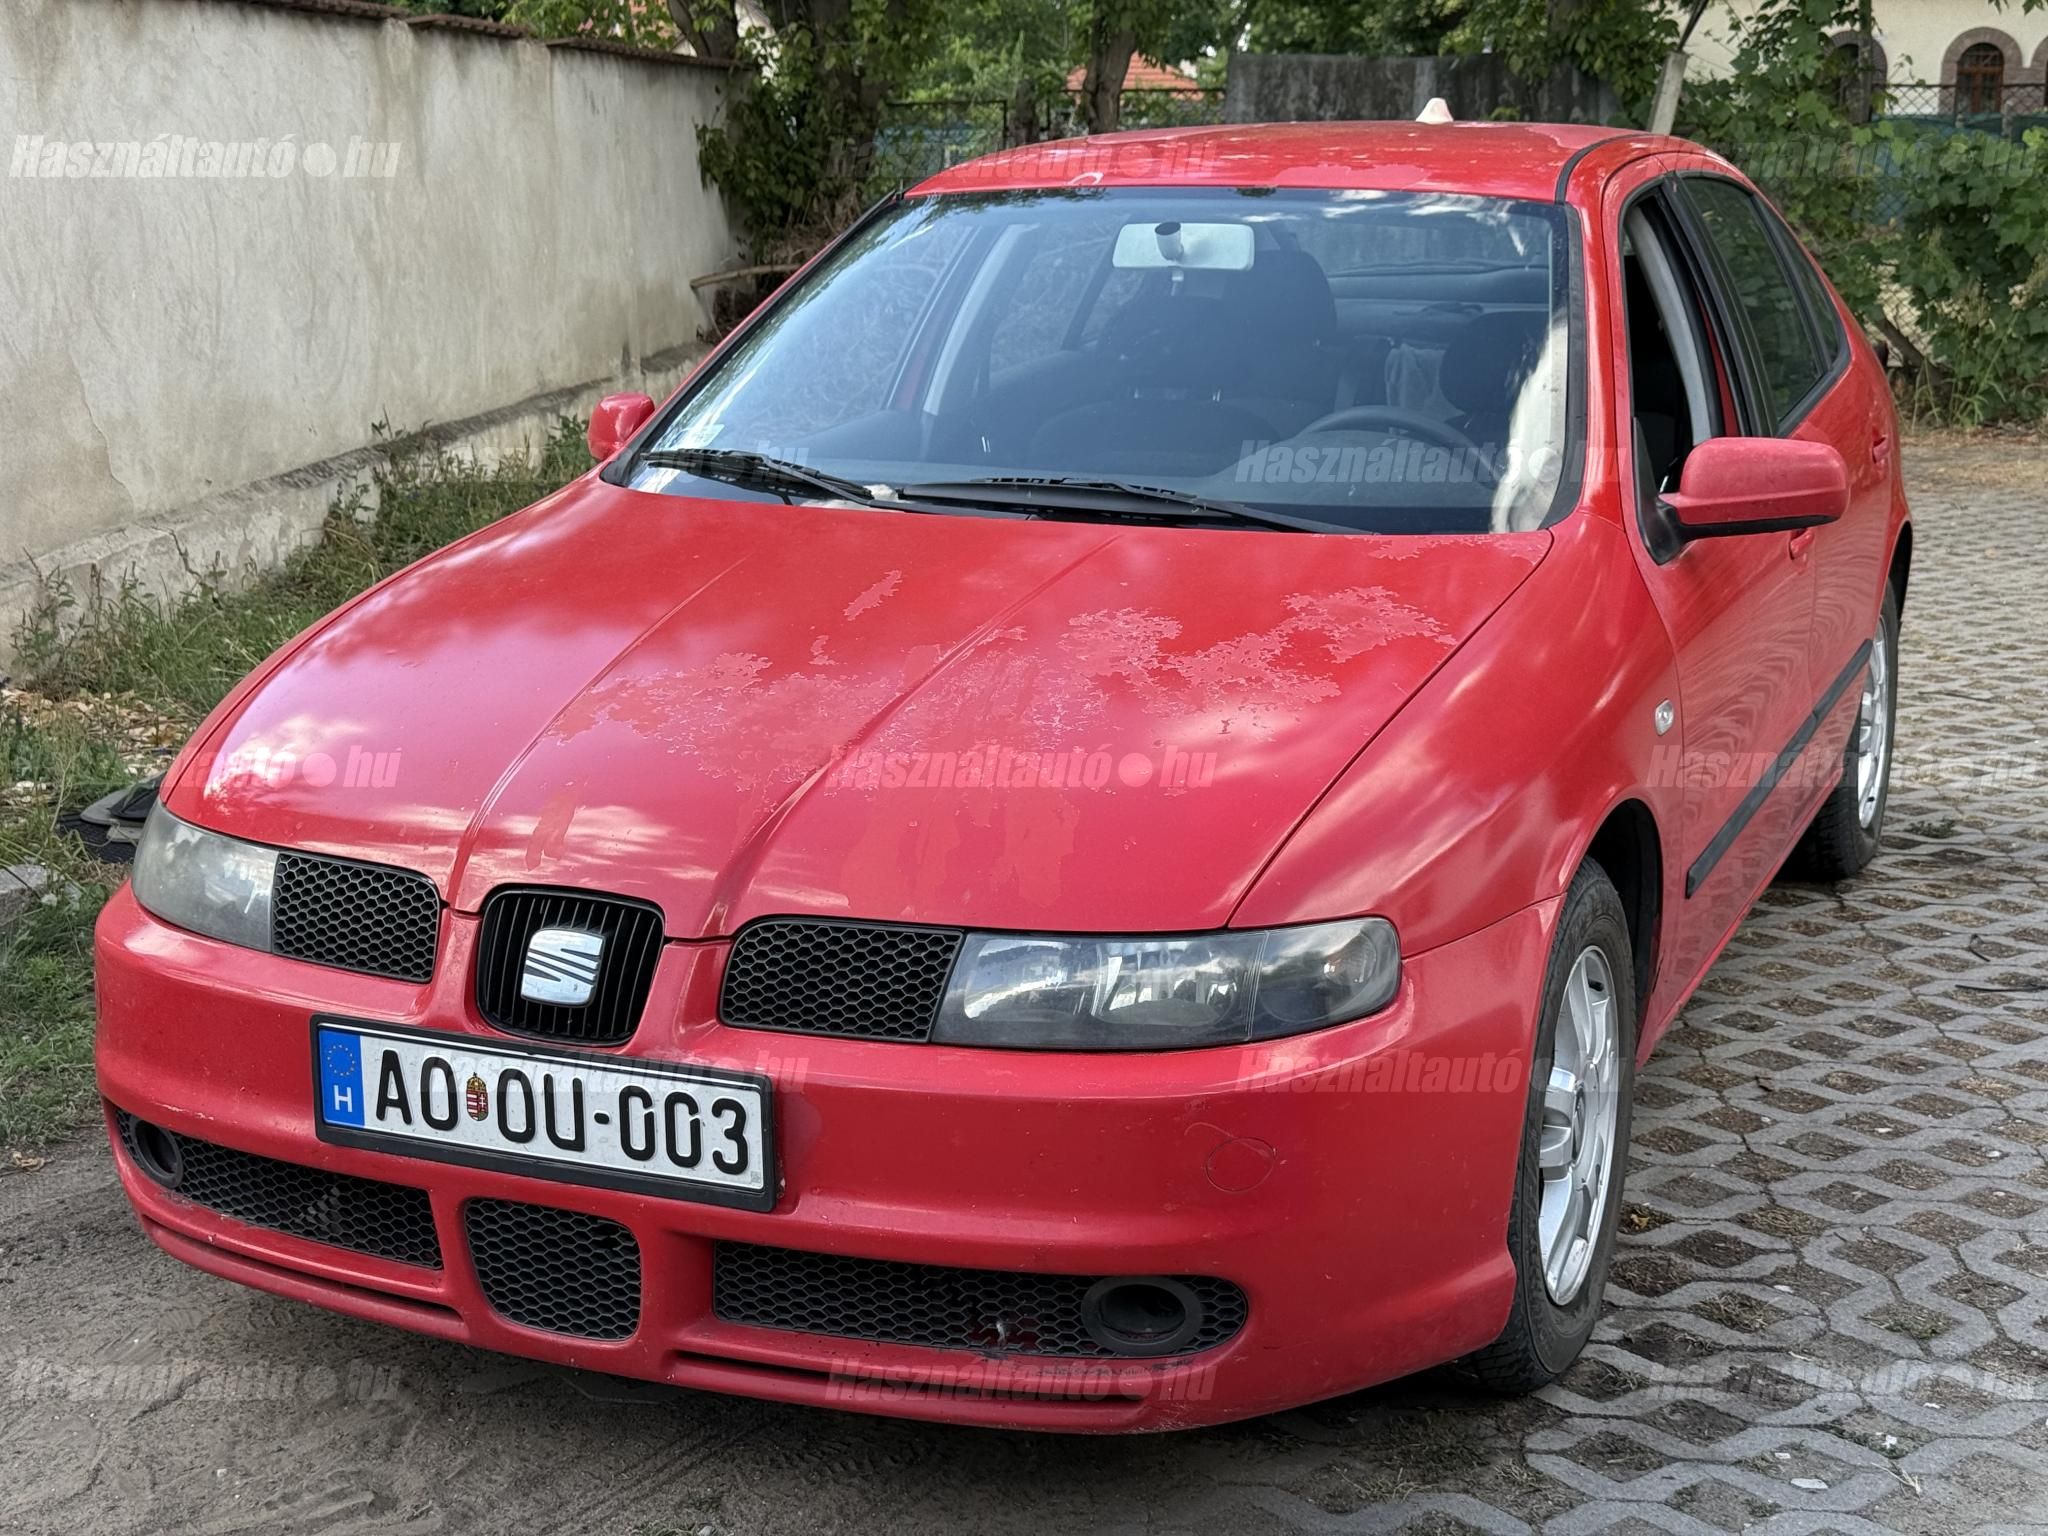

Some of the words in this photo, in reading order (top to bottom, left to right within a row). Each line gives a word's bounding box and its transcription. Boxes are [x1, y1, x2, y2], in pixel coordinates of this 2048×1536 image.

[334, 1085, 353, 1113] H
[375, 1048, 460, 1132] AO
[497, 1067, 749, 1176] OU-003
